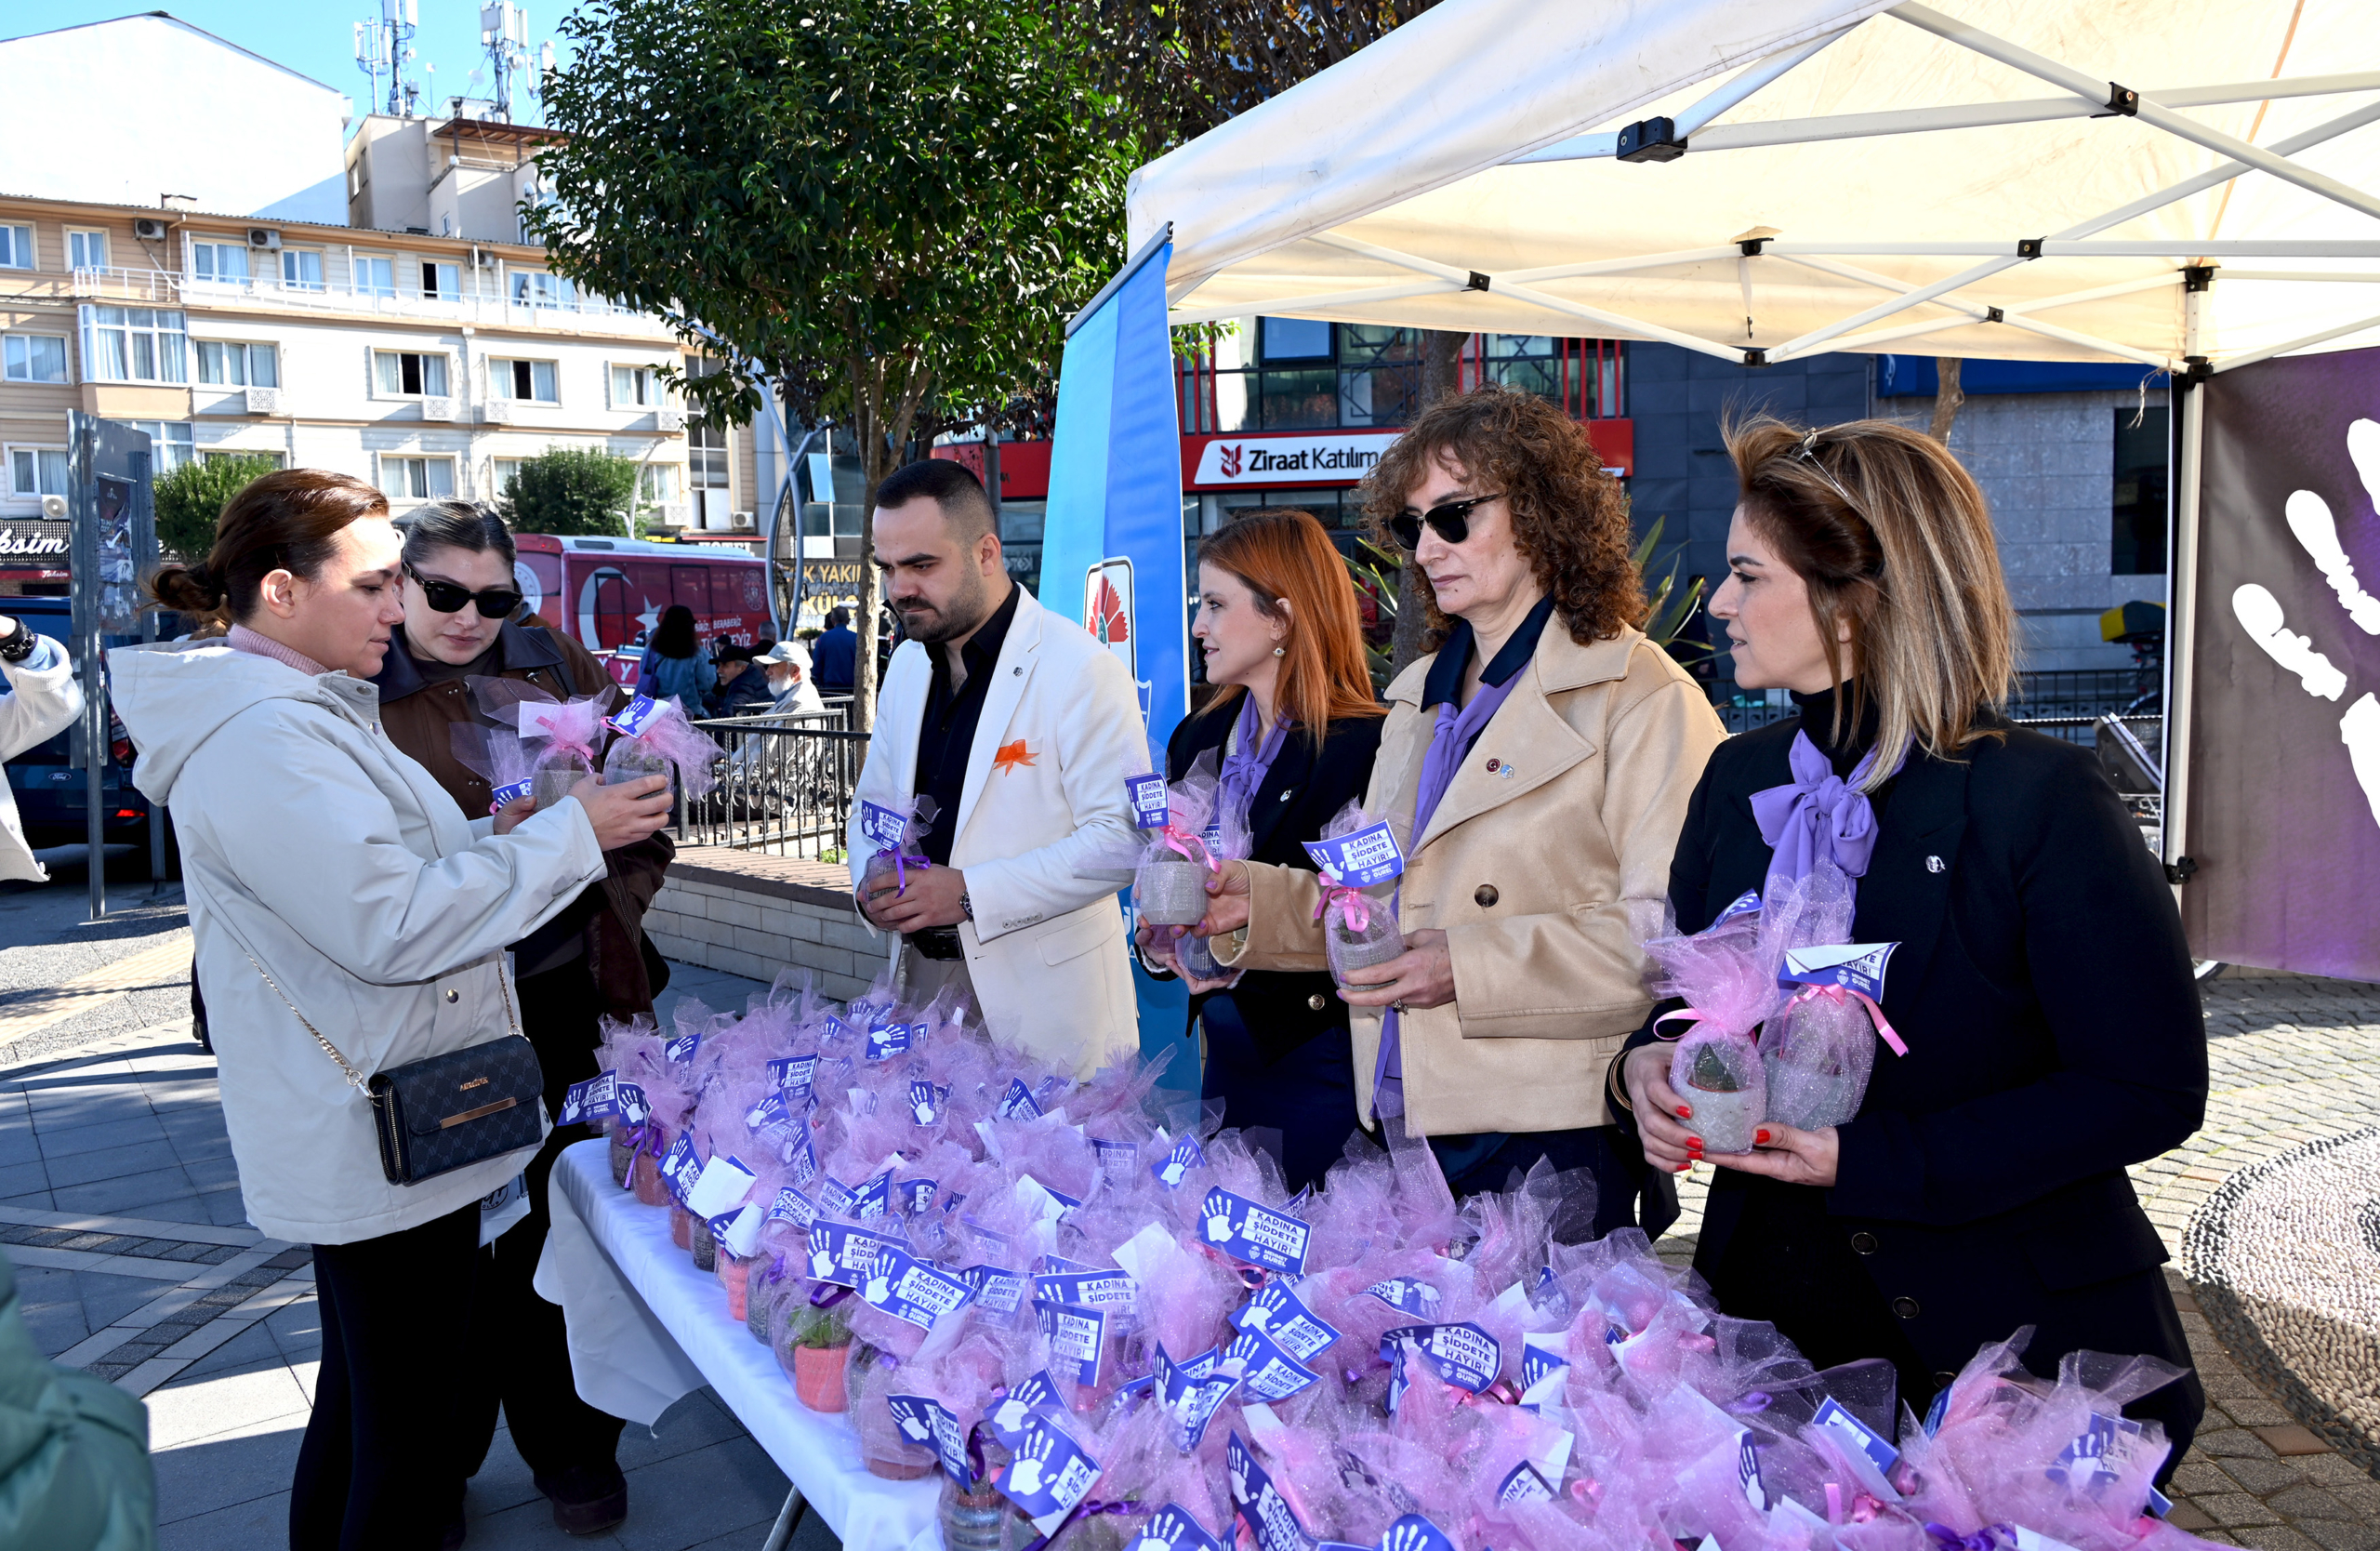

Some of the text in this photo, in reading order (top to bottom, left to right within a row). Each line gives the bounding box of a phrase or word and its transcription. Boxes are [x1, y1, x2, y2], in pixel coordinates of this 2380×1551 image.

[1249, 447, 1380, 471] Ziraat Katılım
[0, 529, 70, 554] ksim
[1142, 782, 1161, 791] KADINA
[1144, 802, 1163, 810] HAYIR!
[1349, 833, 1383, 850] KADINA
[1351, 842, 1388, 861] ŞİDDETE
[1358, 852, 1391, 868] HAYIR!
[684, 1170, 694, 1188] ŞİDD
[690, 1163, 700, 1181] KAD
[1253, 1220, 1298, 1244] ŞİDDETE
[1256, 1211, 1298, 1235] KADINA
[1253, 1233, 1292, 1255] HAYIR!
[851, 1248, 874, 1261] ŞİDD
[917, 1271, 956, 1296] KADINA
[993, 1277, 1021, 1287] KADINA
[1086, 1279, 1128, 1292] KADINA
[908, 1279, 952, 1306] ŞİDDETE
[986, 1287, 1018, 1298] ŞİDDETE
[906, 1292, 942, 1315] HAYIR!
[984, 1299, 1011, 1310] HAYIR!
[1289, 1327, 1317, 1347] ŞİDDETE
[1299, 1317, 1328, 1341] KADINA
[1280, 1336, 1303, 1355] HAYIR!
[1445, 1327, 1490, 1351] KADINA
[1058, 1344, 1085, 1359] HAYIR!
[1443, 1335, 1491, 1363] ŞİDDETE
[1445, 1348, 1488, 1374] HAYIR!
[1264, 1372, 1294, 1391] ŞİDDETE
[1274, 1362, 1304, 1385] KADINA
[1457, 1366, 1482, 1382] MEHMET
[1271, 1492, 1296, 1538] KADIN
